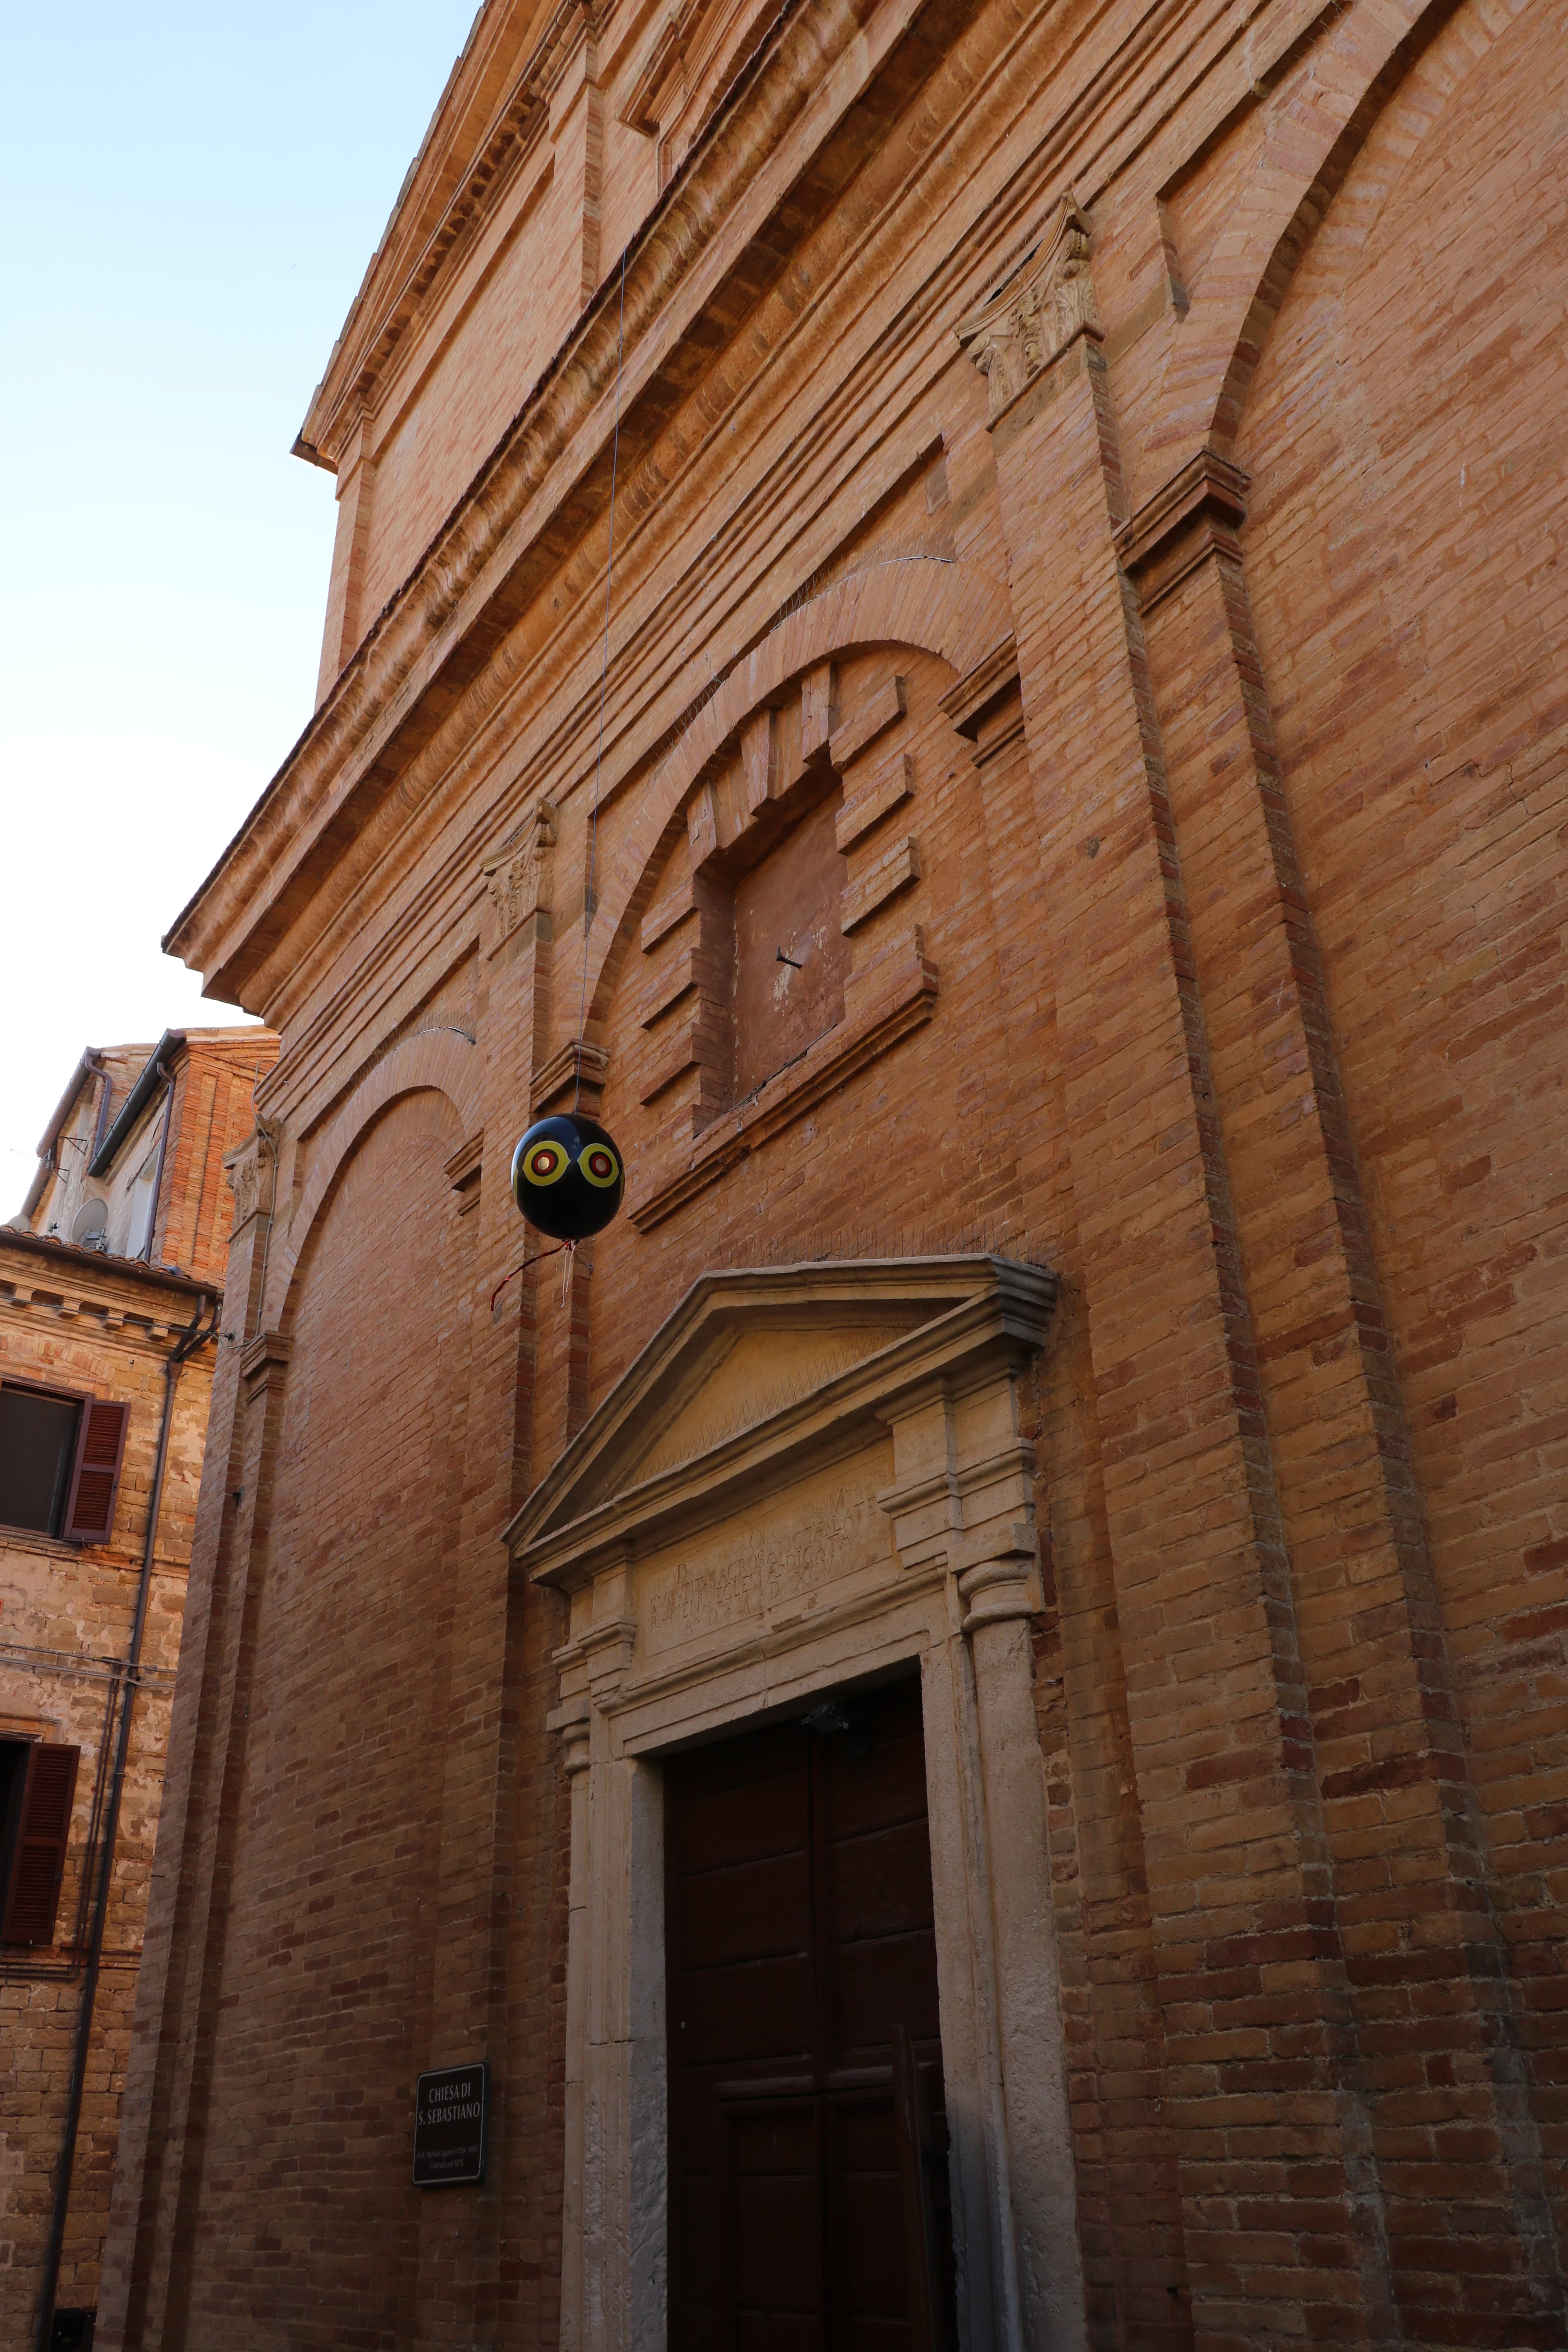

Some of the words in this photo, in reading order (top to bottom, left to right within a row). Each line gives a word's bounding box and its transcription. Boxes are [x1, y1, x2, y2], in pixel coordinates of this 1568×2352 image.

[676, 1563, 687, 1585] D
[829, 1488, 844, 1514] M
[429, 2084, 459, 2103] CHIESA
[461, 2082, 471, 2098] DI
[418, 2111, 425, 2126] S.
[428, 2102, 480, 2125] SEBASTIANO
